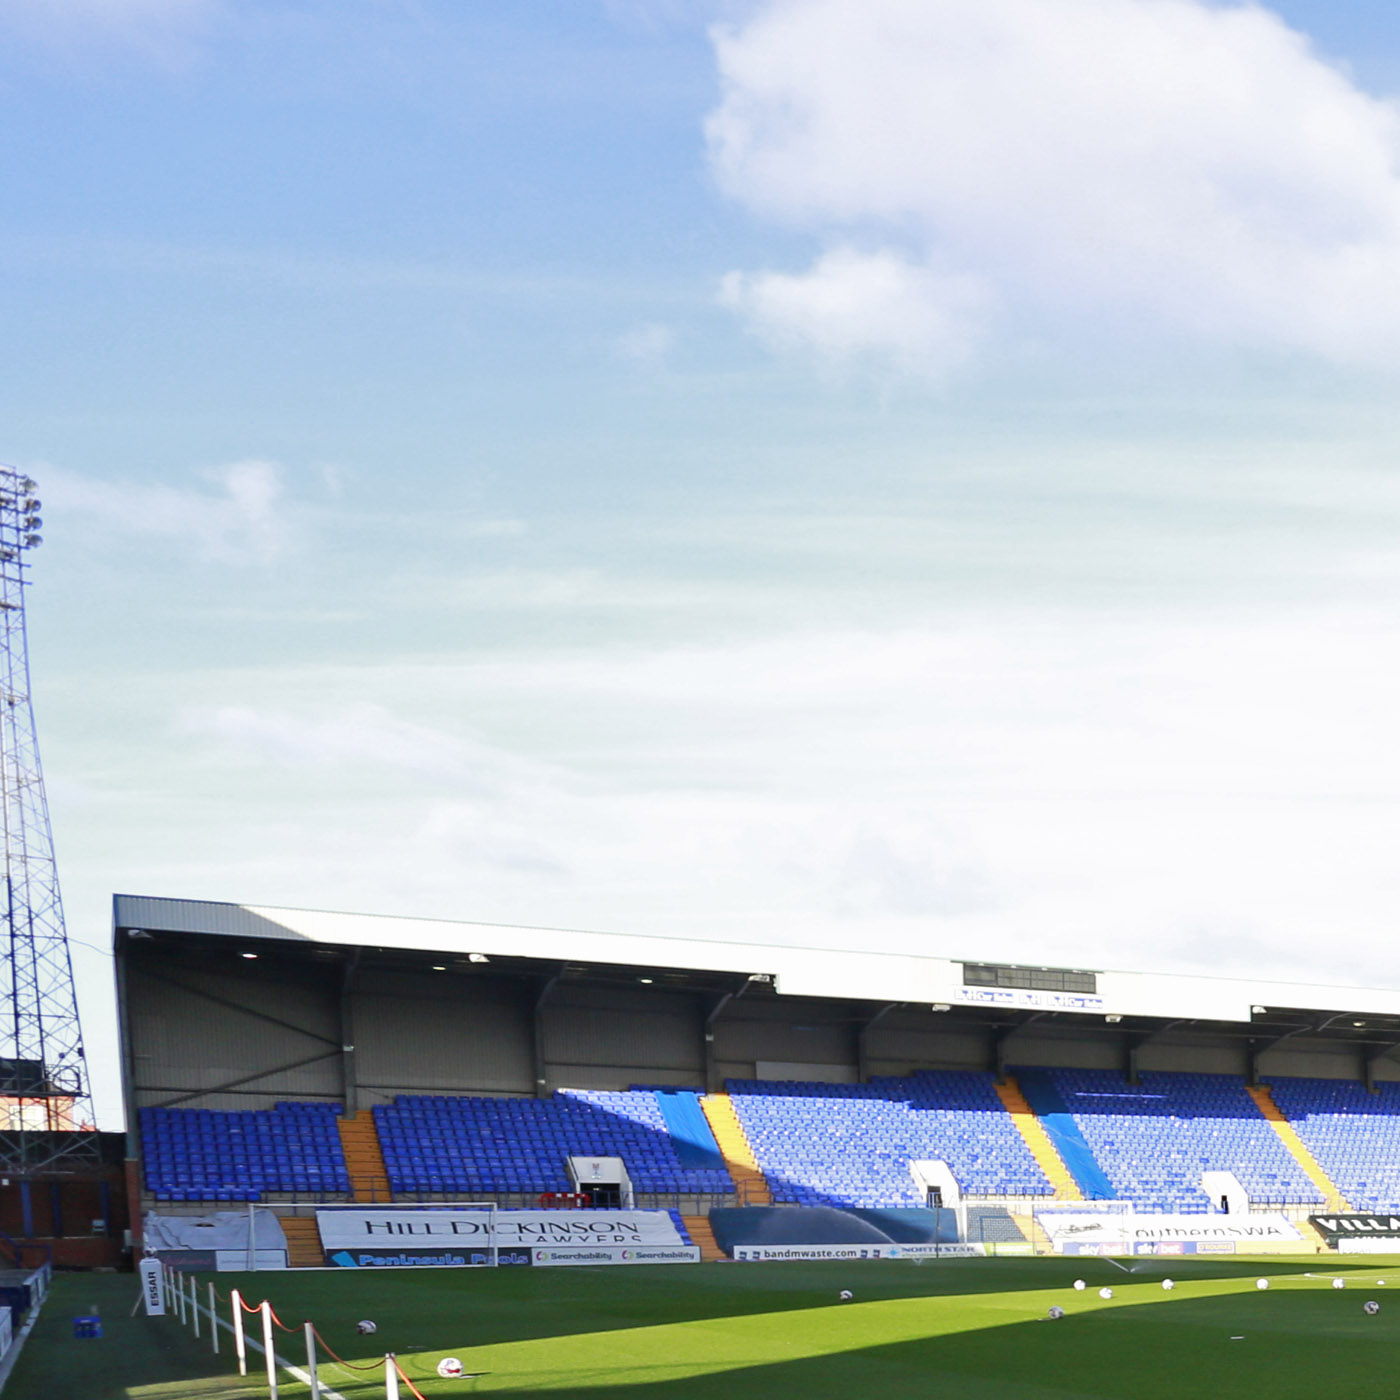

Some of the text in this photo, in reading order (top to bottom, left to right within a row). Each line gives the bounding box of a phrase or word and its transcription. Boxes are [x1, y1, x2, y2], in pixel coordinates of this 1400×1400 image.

[364, 1220, 640, 1236] HILL DICKINSON
[518, 1235, 642, 1243] LAWYERS
[764, 1249, 857, 1258] bandmwaste.com
[1138, 1243, 1181, 1255] sky bet
[359, 1253, 529, 1266] Peninsula Pools
[551, 1252, 612, 1261] Searchability
[635, 1251, 695, 1260] Searchability
[150, 1271, 158, 1307] ESSAR
